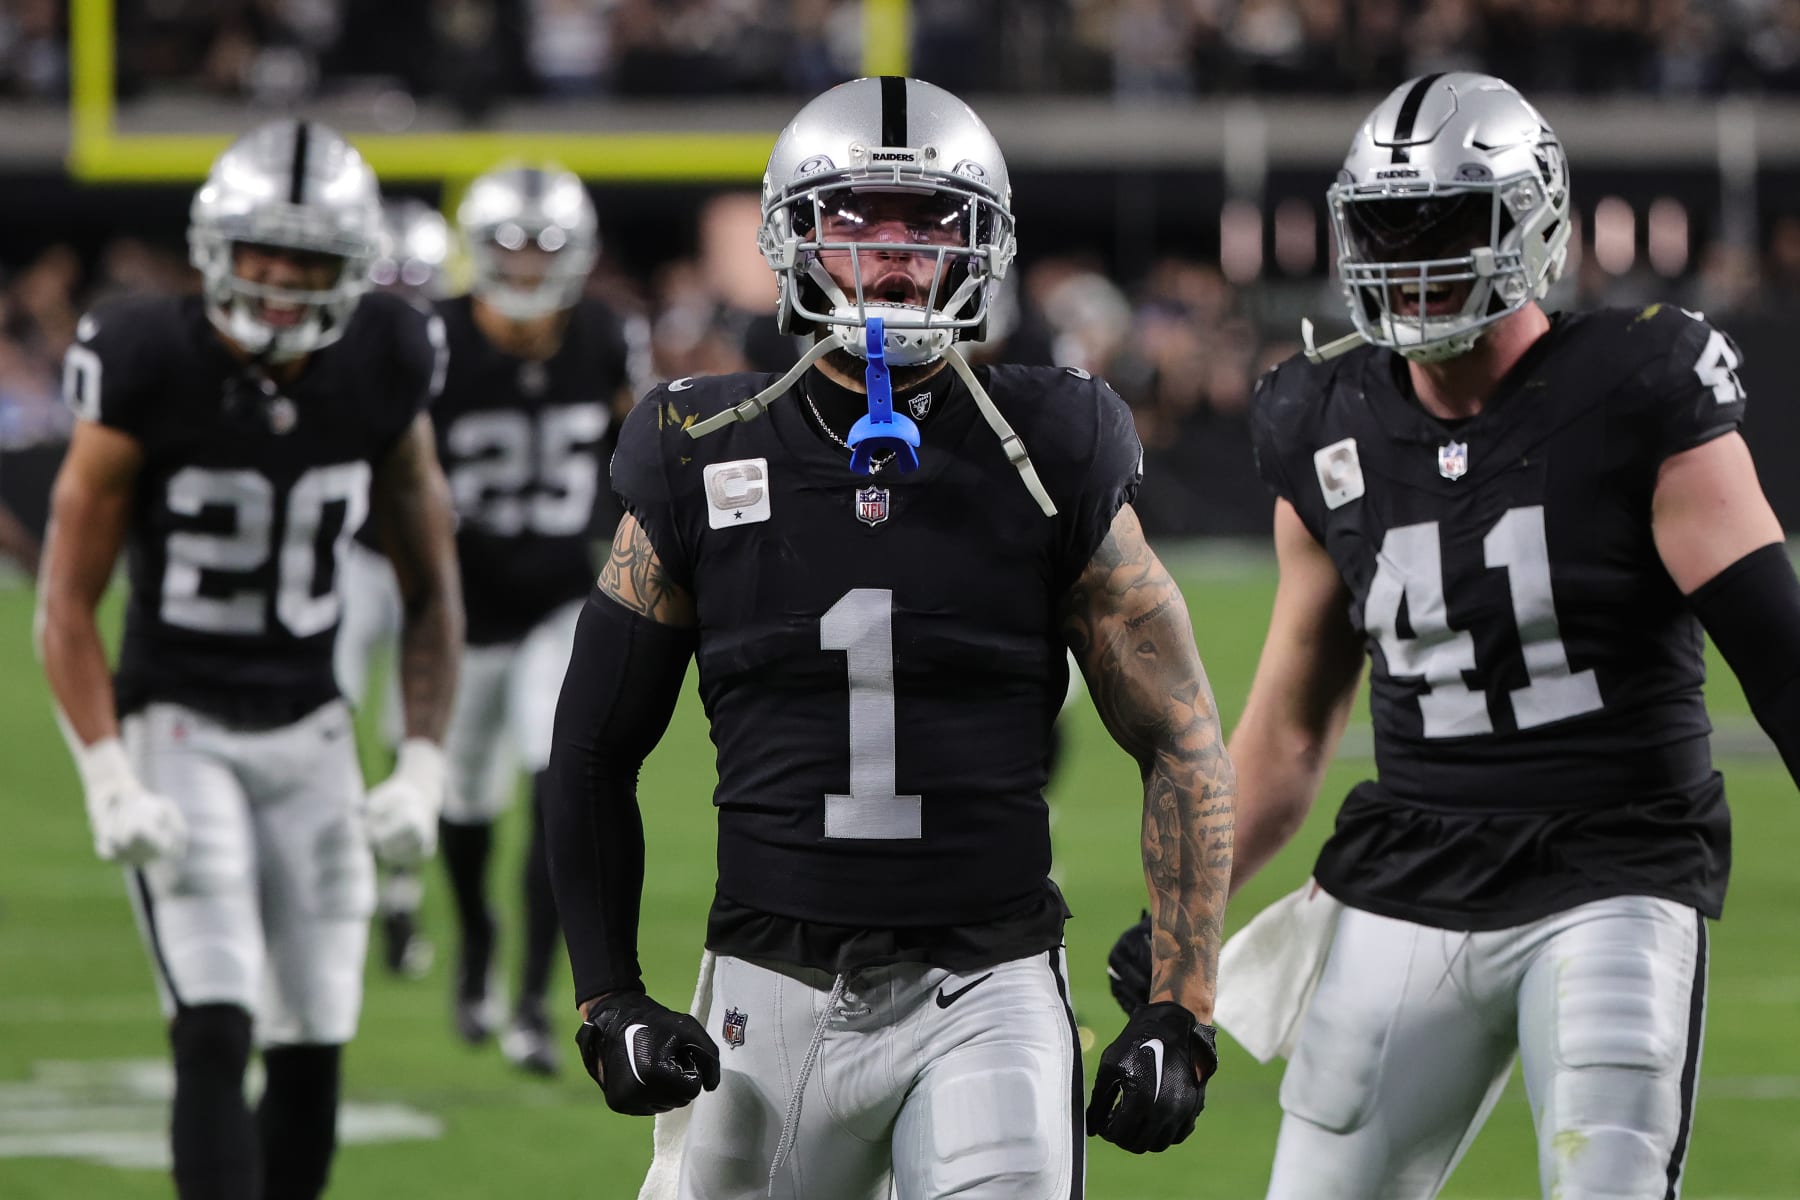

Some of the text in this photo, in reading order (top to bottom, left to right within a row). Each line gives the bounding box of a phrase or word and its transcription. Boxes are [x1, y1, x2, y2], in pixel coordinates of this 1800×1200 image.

[872, 153, 914, 161] RAIDERS
[448, 403, 609, 538] 25
[711, 463, 763, 511] C
[861, 503, 884, 519] NFL
[160, 460, 373, 637] 20
[1364, 505, 1604, 738] 41
[820, 588, 922, 839] 1
